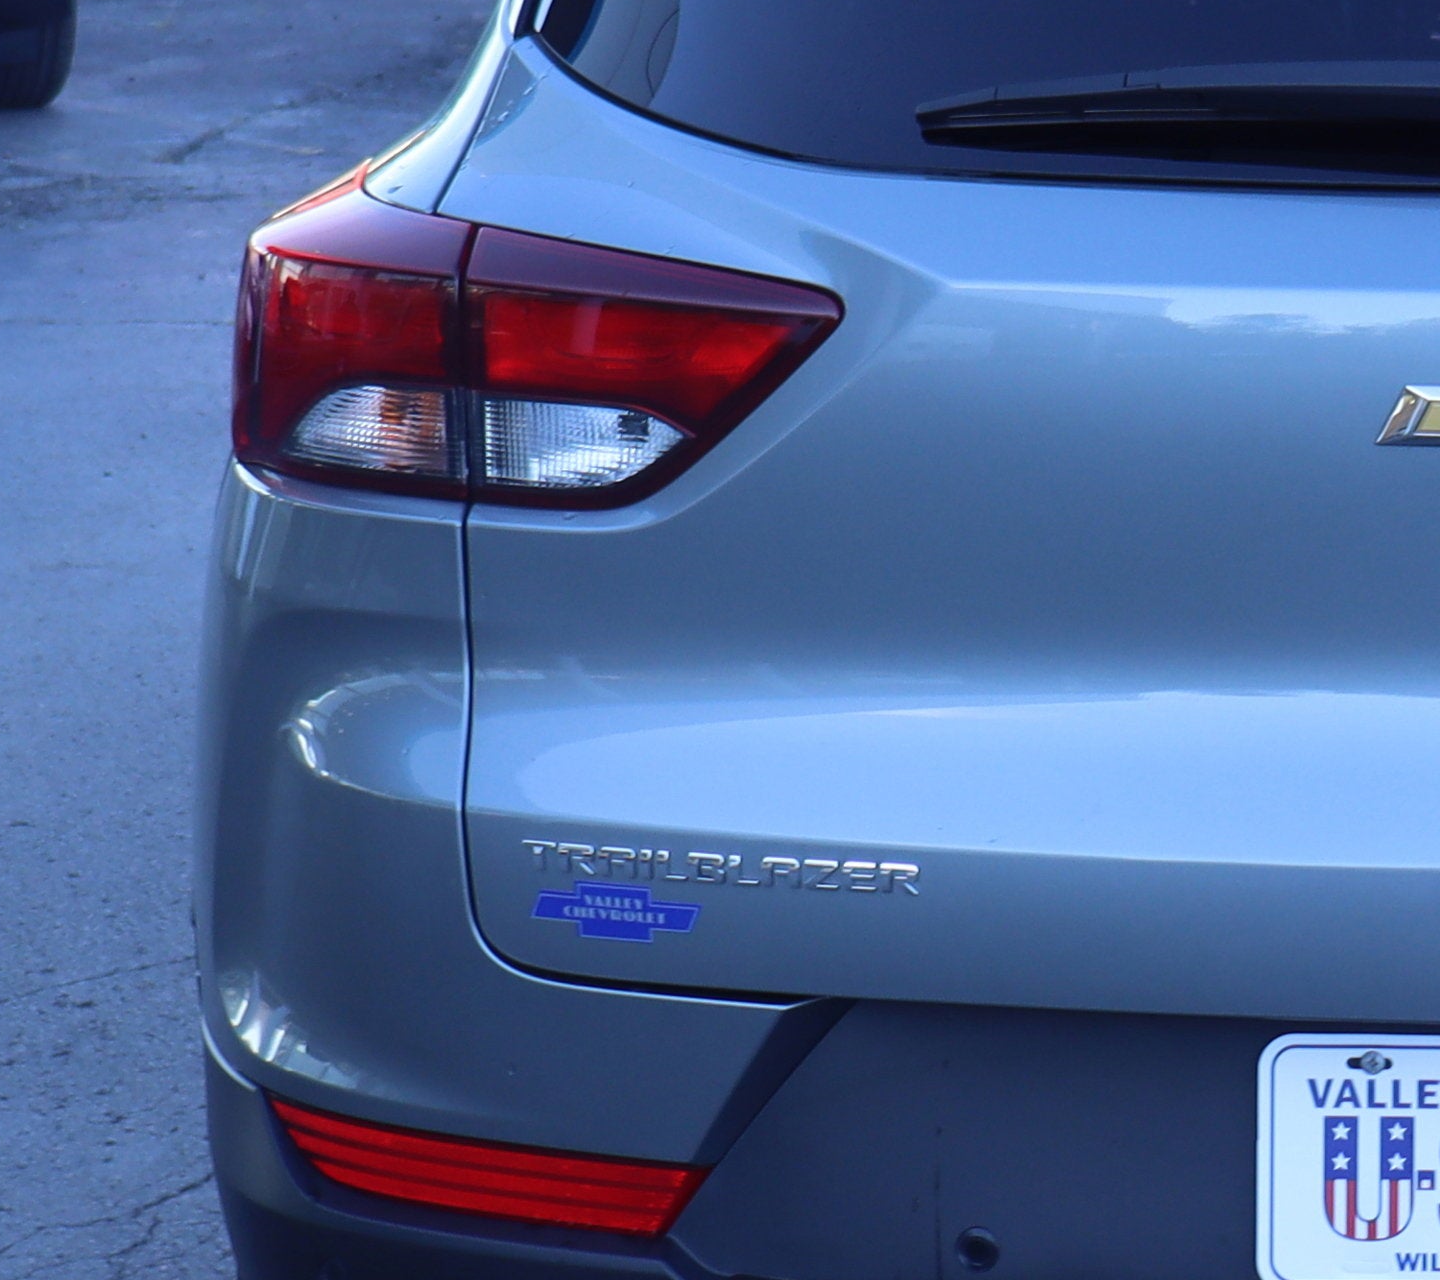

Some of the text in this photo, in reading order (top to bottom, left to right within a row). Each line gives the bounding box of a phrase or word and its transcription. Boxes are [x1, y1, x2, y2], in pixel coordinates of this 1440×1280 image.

[522, 838, 921, 896] TRAILBLAZER
[583, 894, 643, 910] VALLEY
[563, 905, 666, 925] CHEVROLET
